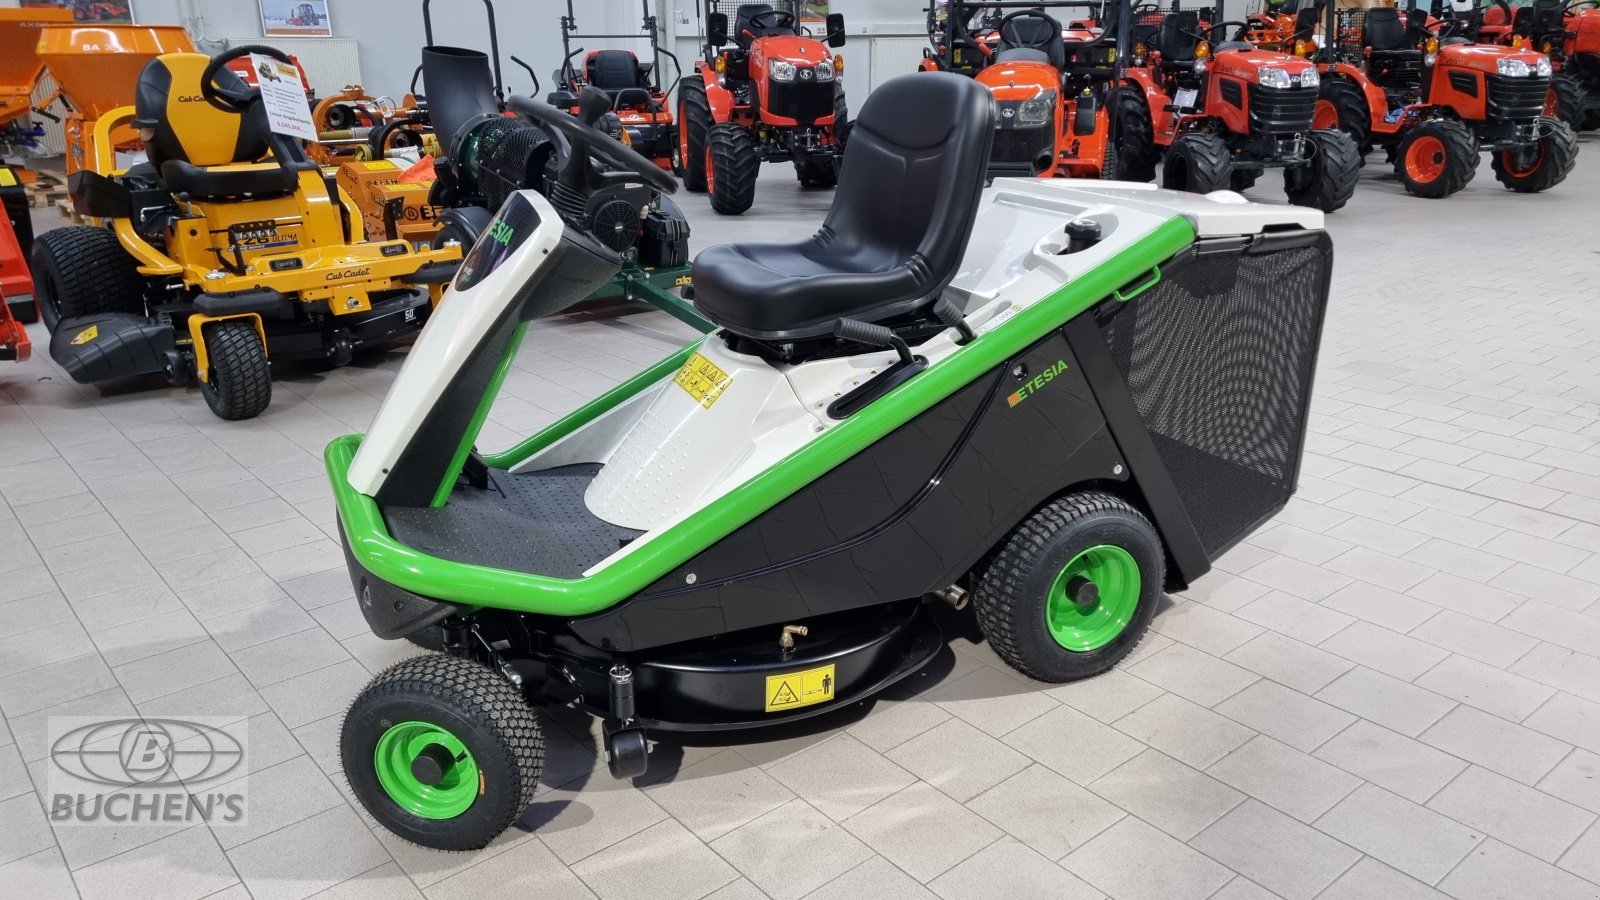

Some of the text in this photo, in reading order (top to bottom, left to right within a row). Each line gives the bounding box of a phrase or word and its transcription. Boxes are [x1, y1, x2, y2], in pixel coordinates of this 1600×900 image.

[272, 233, 298, 243] ULTIMA
[326, 267, 371, 280] Cub Cadet
[1017, 359, 1069, 402] ETESIA
